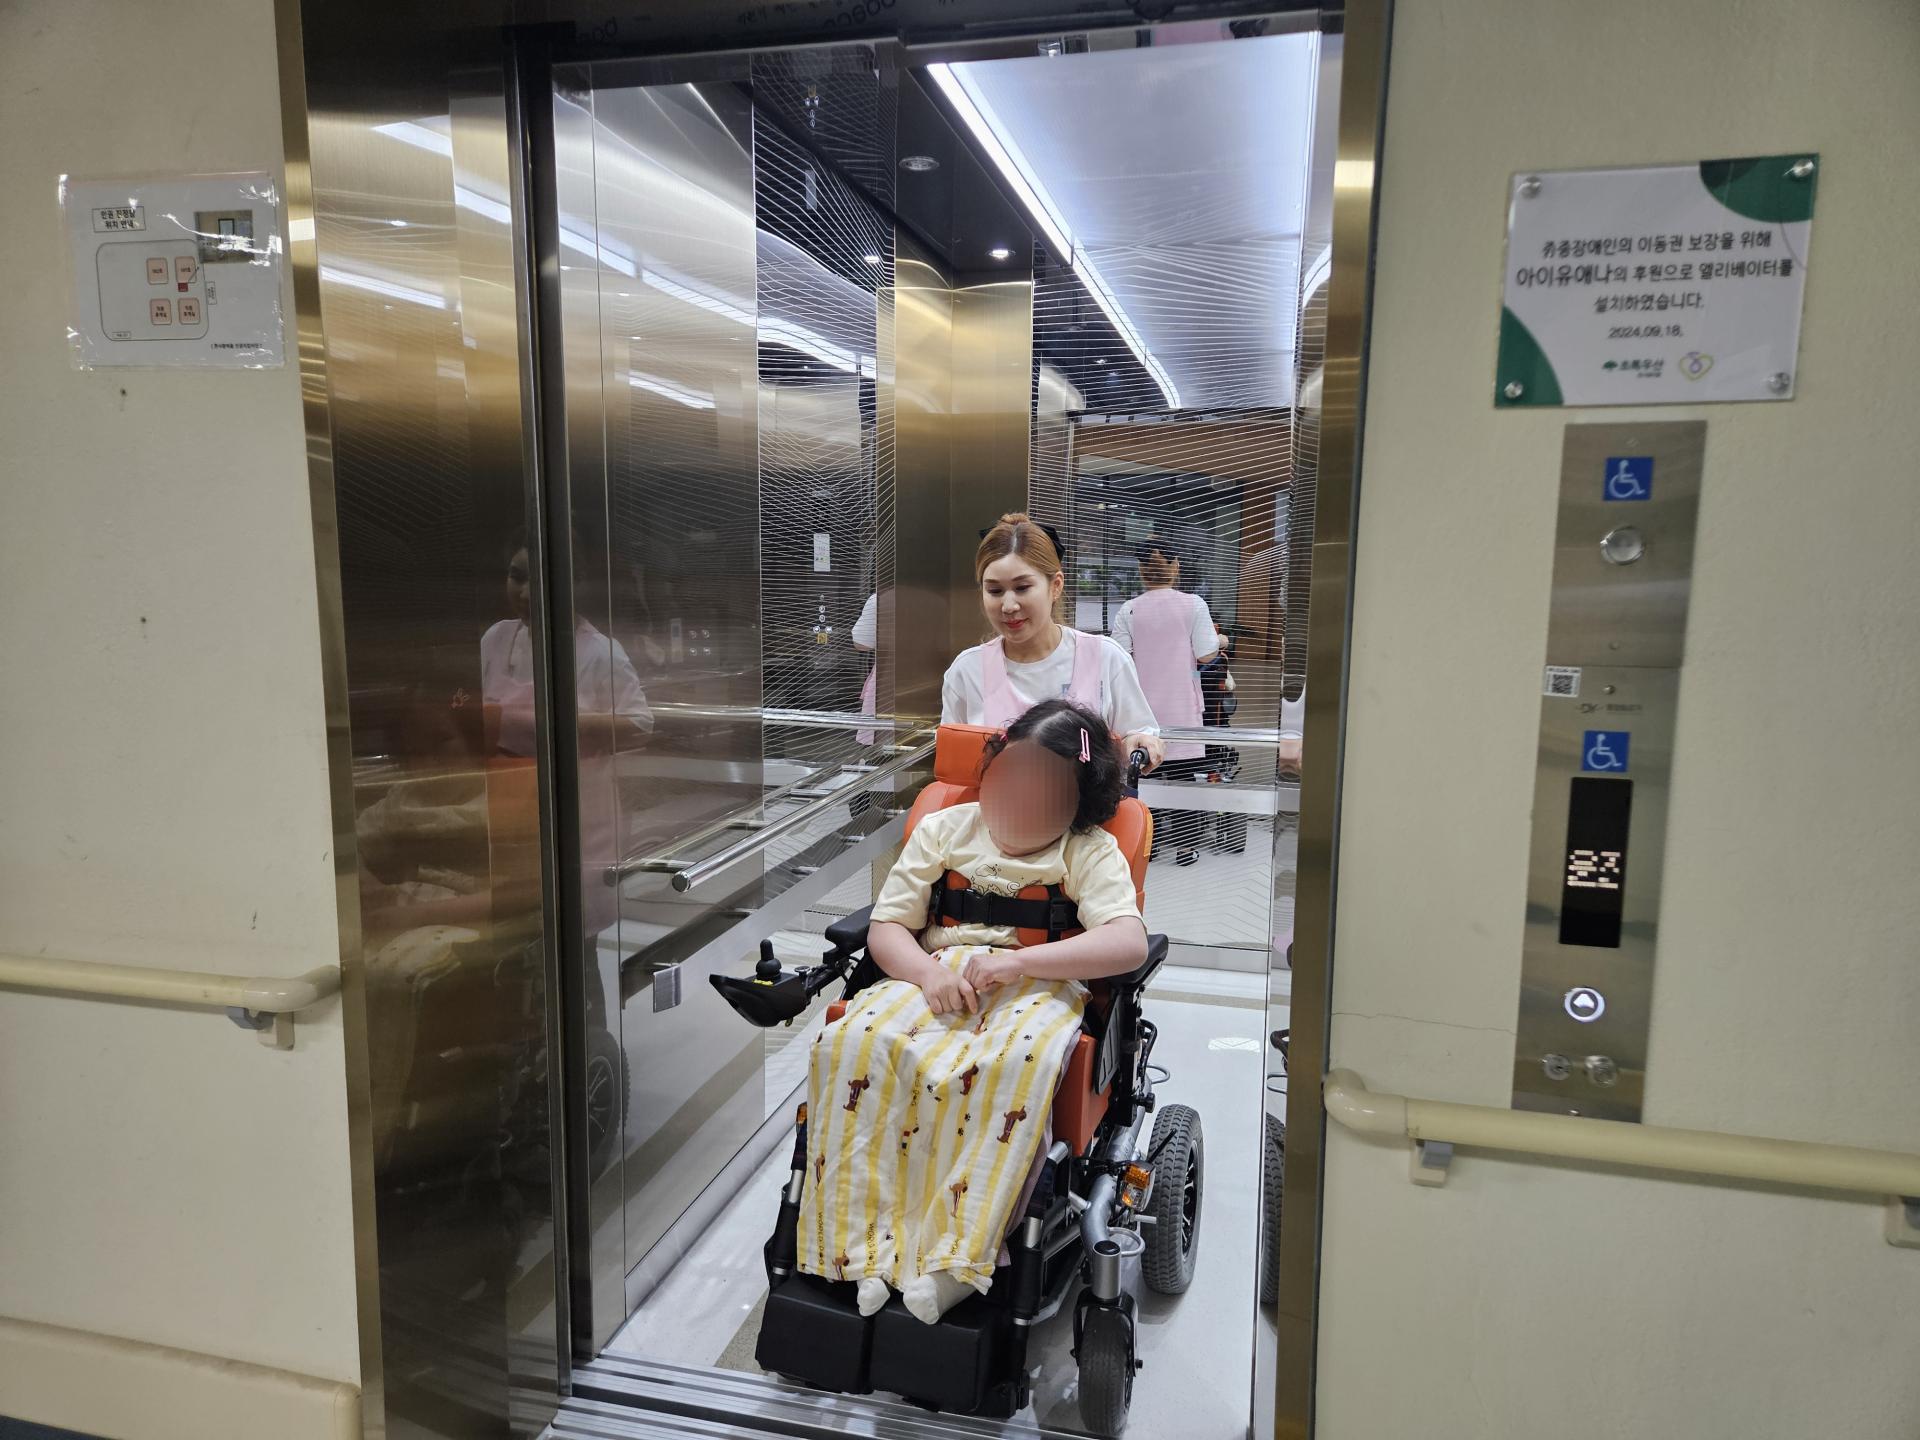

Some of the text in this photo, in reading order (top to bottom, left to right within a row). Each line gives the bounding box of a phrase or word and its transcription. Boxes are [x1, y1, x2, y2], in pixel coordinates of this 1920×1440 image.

[1638, 235, 1683, 253] 이동권
[1687, 231, 1735, 252] 보장을
[1740, 229, 1772, 249] 위해
[1516, 258, 1793, 288] 아이유애나의 후원으로 엘리베이터를
[1594, 292, 1704, 314] 설치하였습니다.
